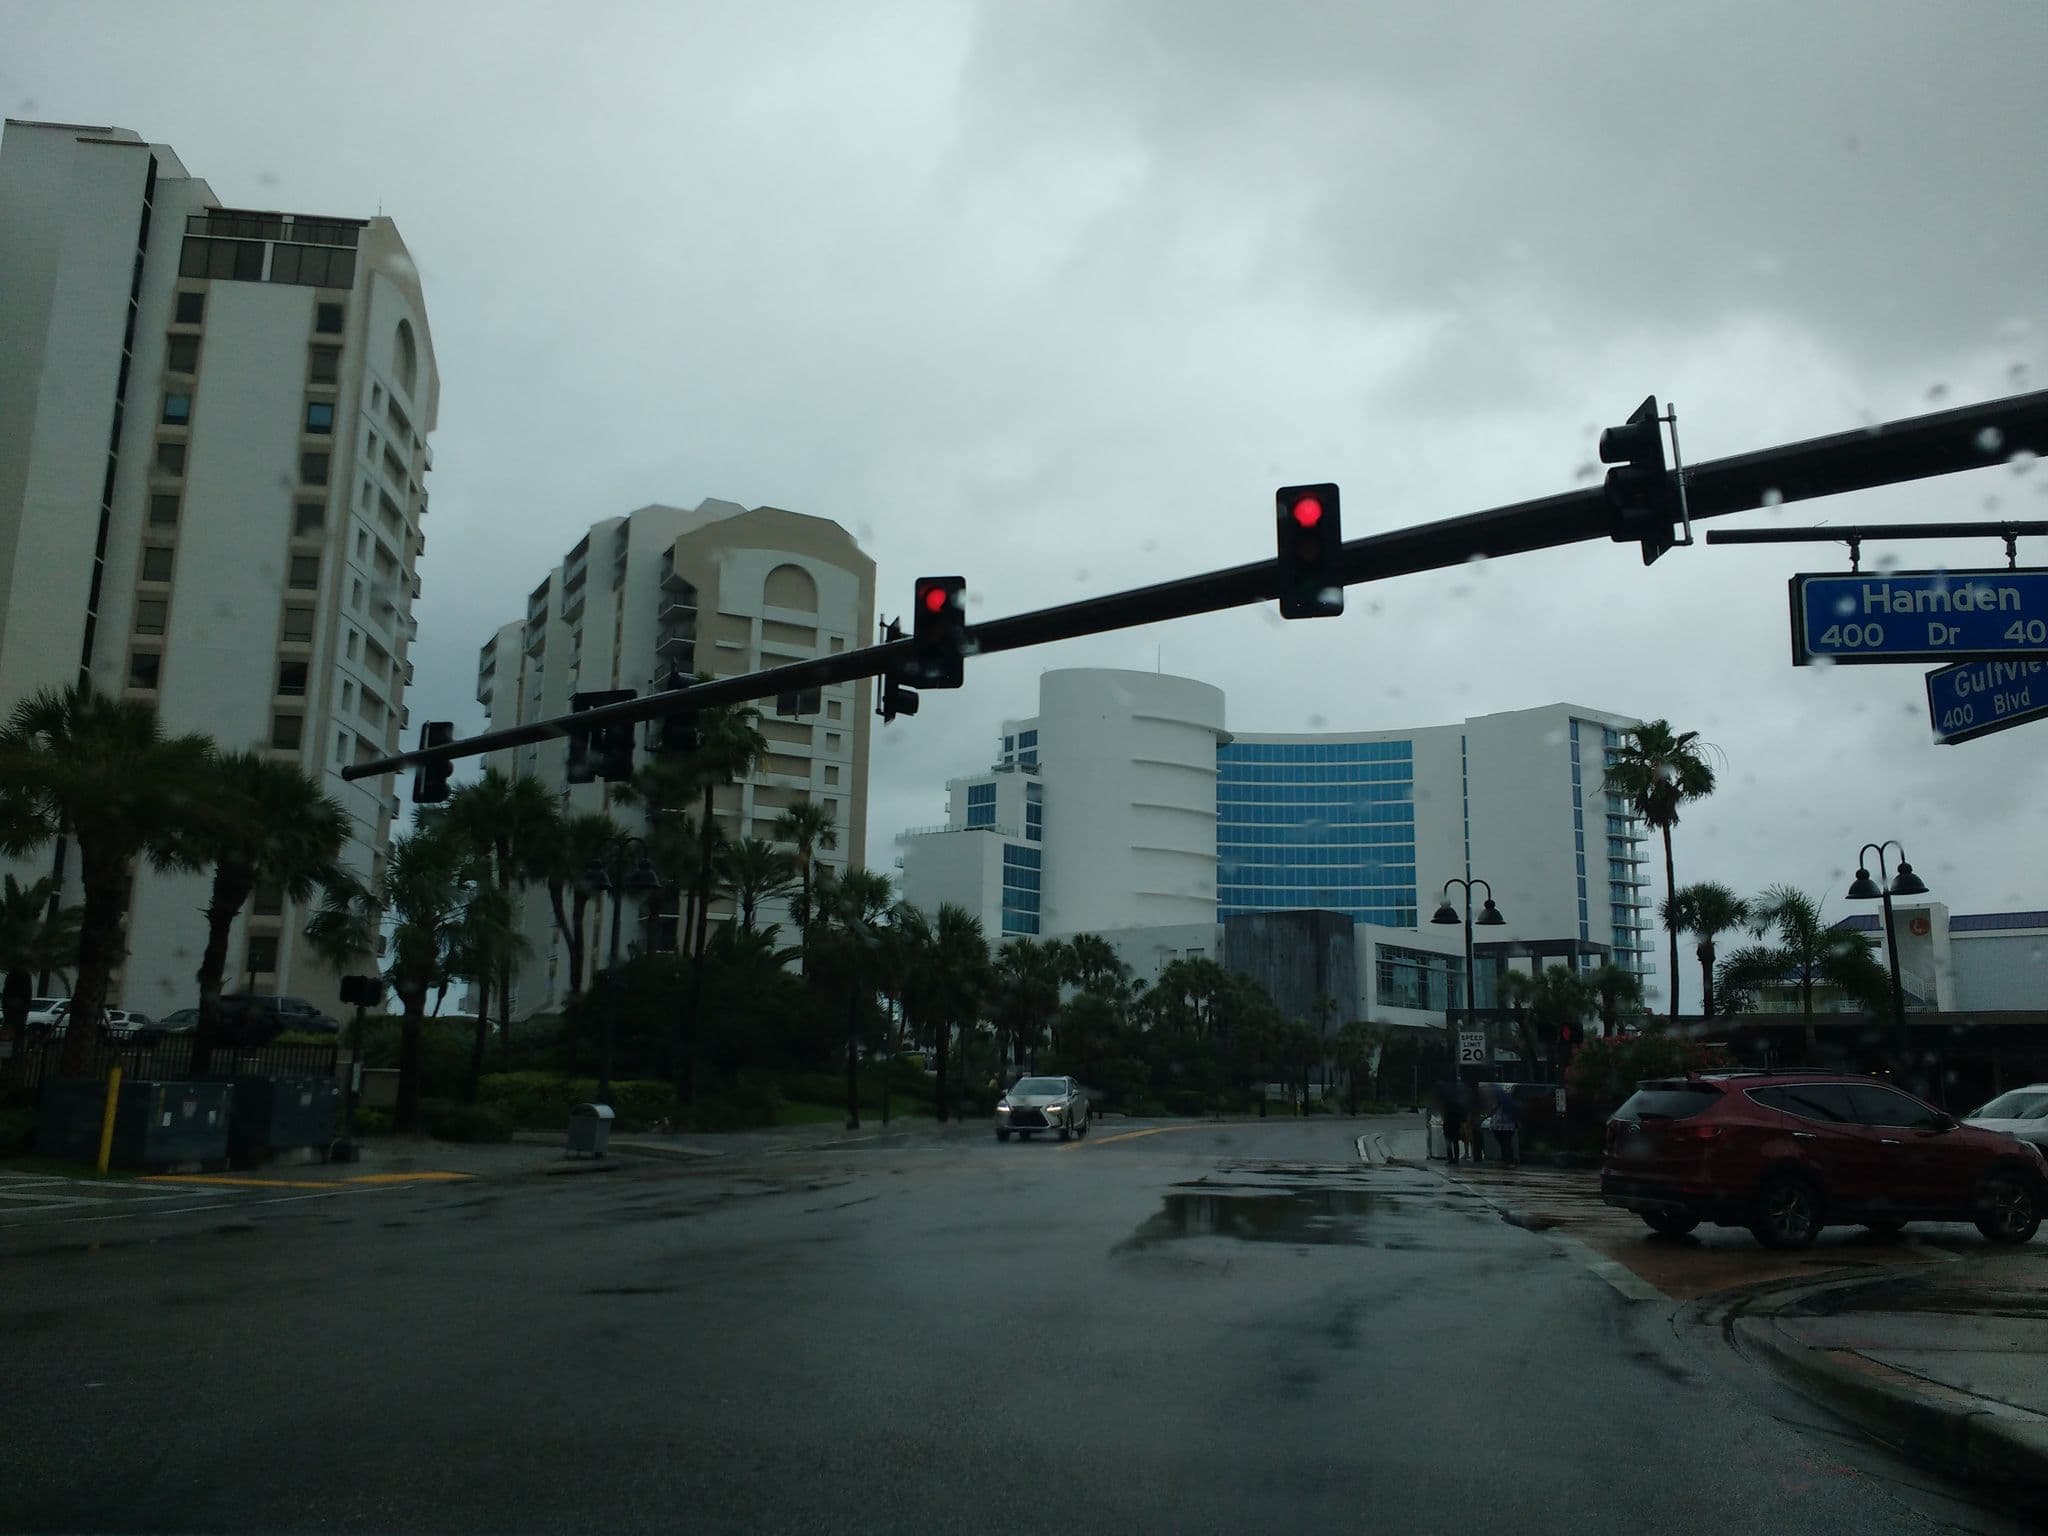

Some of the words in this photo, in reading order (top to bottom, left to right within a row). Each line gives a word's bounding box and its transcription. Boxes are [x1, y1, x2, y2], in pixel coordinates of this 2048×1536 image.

[1862, 582, 2021, 614] Hamden
[1820, 623, 1885, 648] 400
[1928, 622, 1961, 646] Dr
[1954, 661, 2048, 698] Gulfvie
[1942, 704, 1974, 729] 400
[1993, 686, 2031, 715] Blvd
[1462, 1048, 1484, 1061] 20
